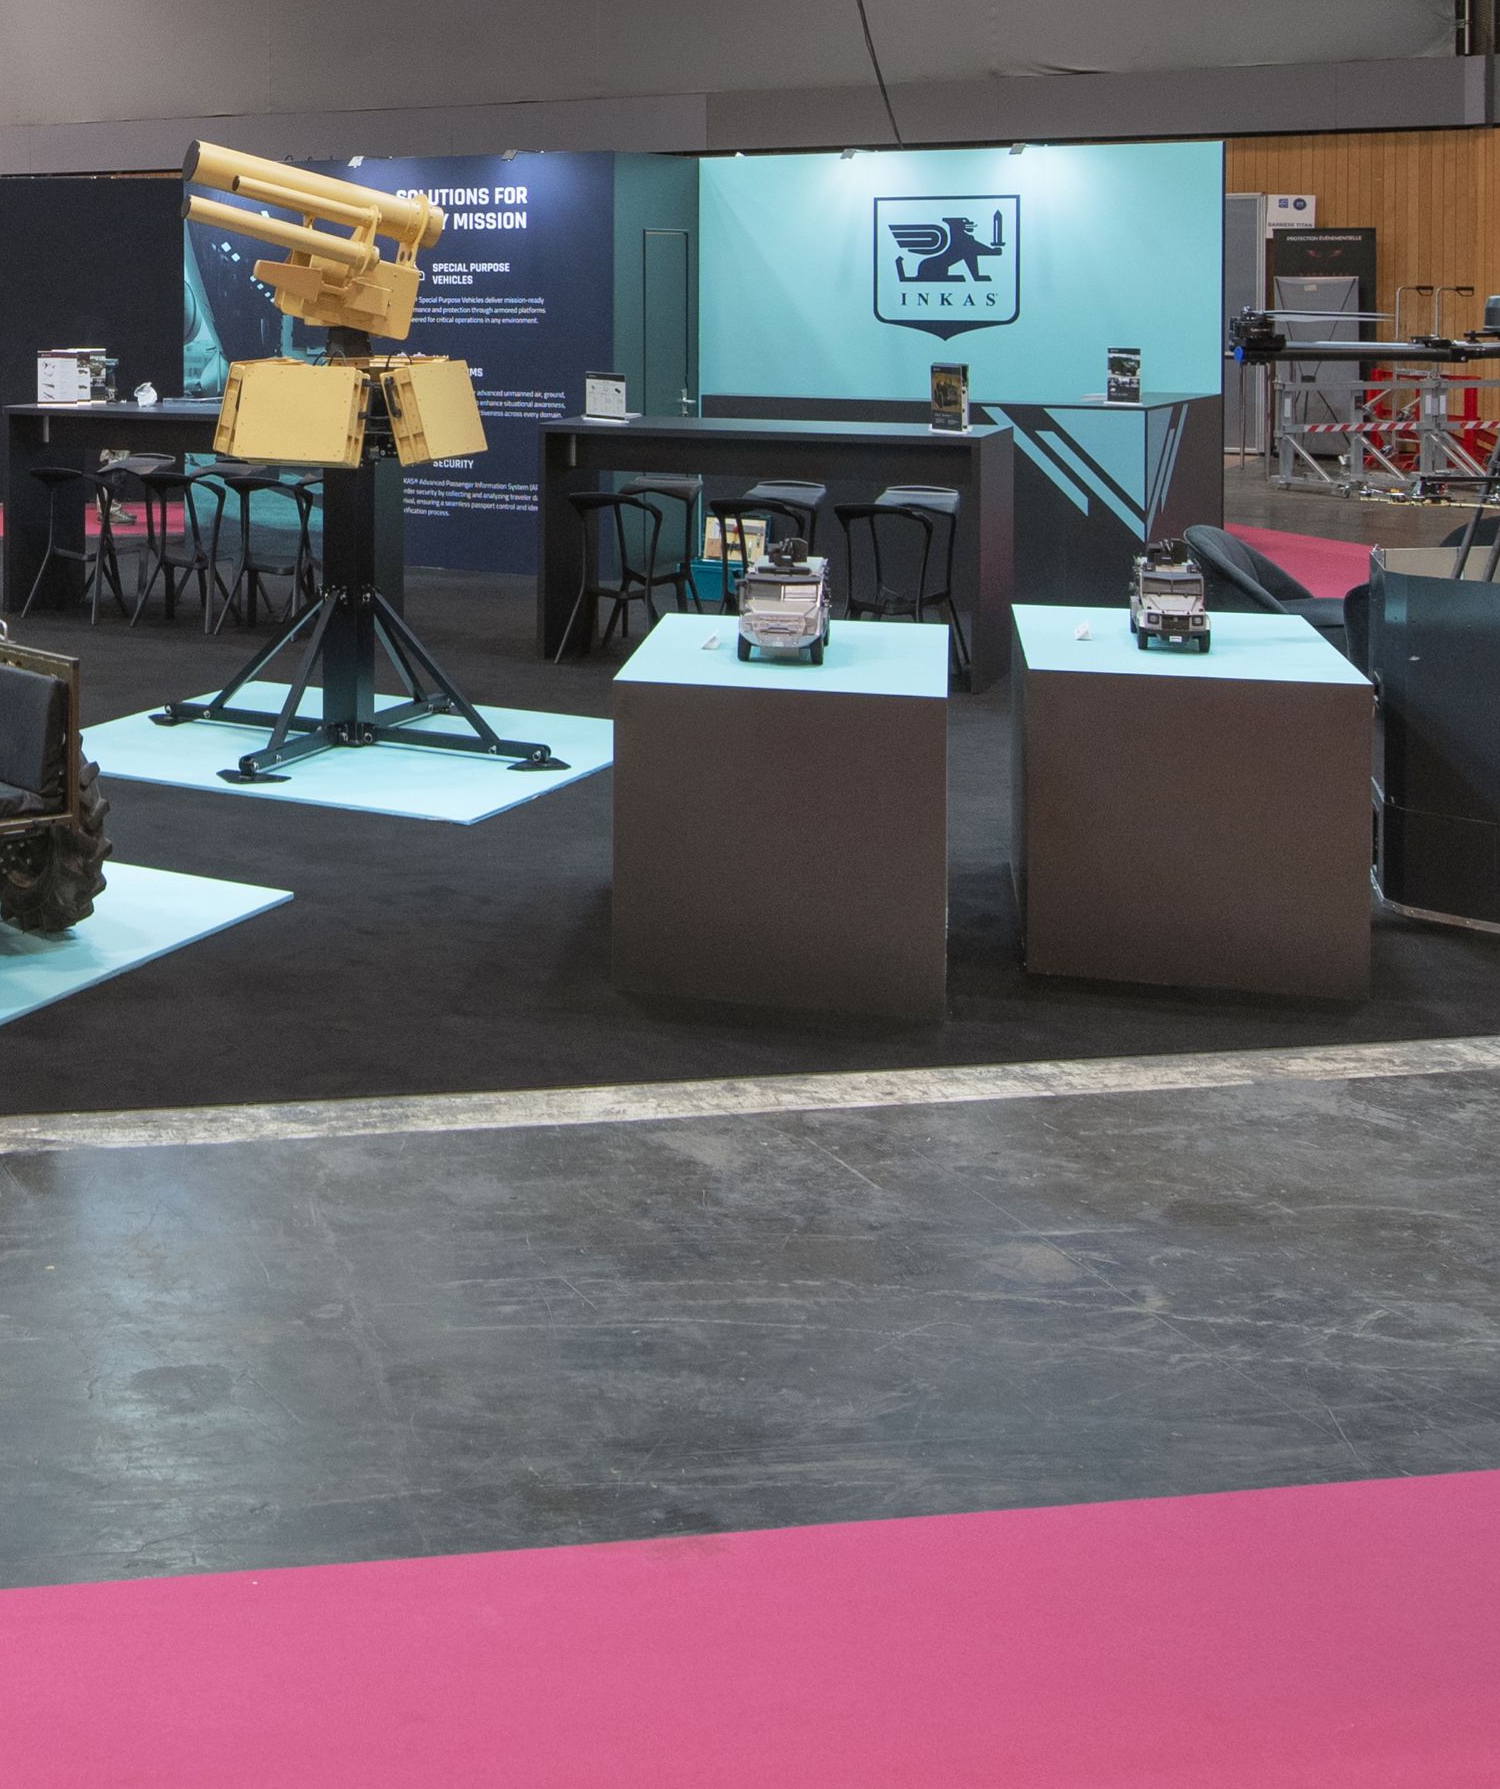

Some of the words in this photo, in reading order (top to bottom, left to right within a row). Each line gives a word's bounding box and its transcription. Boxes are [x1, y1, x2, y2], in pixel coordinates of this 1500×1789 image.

[494, 187, 528, 204] FOR
[453, 212, 527, 230] MISSION
[432, 263, 468, 272] SPECIAL
[470, 262, 510, 272] PURPOSE
[432, 275, 473, 285] VEHICLES
[901, 292, 996, 306] INKAS
[433, 460, 474, 469] SECURITY
